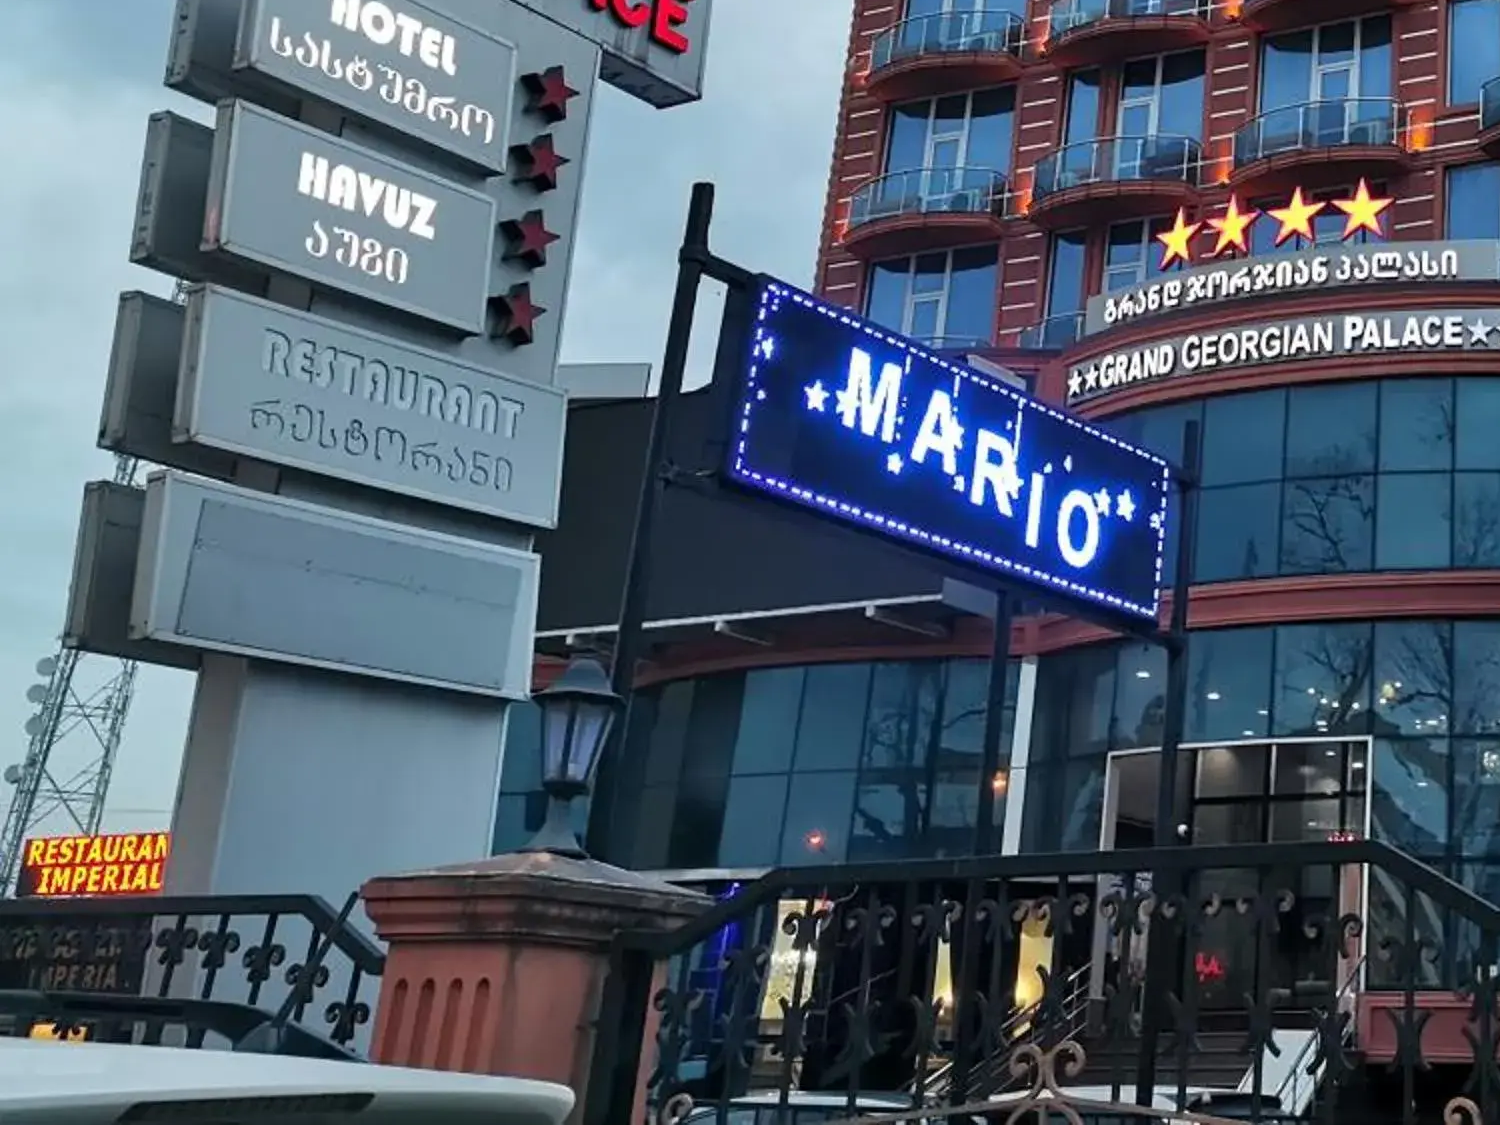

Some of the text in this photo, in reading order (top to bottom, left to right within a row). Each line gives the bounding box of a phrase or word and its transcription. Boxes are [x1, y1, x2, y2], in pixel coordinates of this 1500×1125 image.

[270, 16, 496, 144] სასტუმრო
[298, 151, 438, 240] HAVUZ
[305, 219, 409, 284] აუზი
[1104, 249, 1458, 324] გრანდ ჯორჯიან პალასი
[261, 328, 526, 440] RESTAURANT
[1098, 314, 1464, 389] GRAND GEORGIAN PALACE
[250, 398, 514, 492] რესტორანი
[840, 345, 1100, 569] MARIO
[36, 862, 163, 894] IMPERIAL
